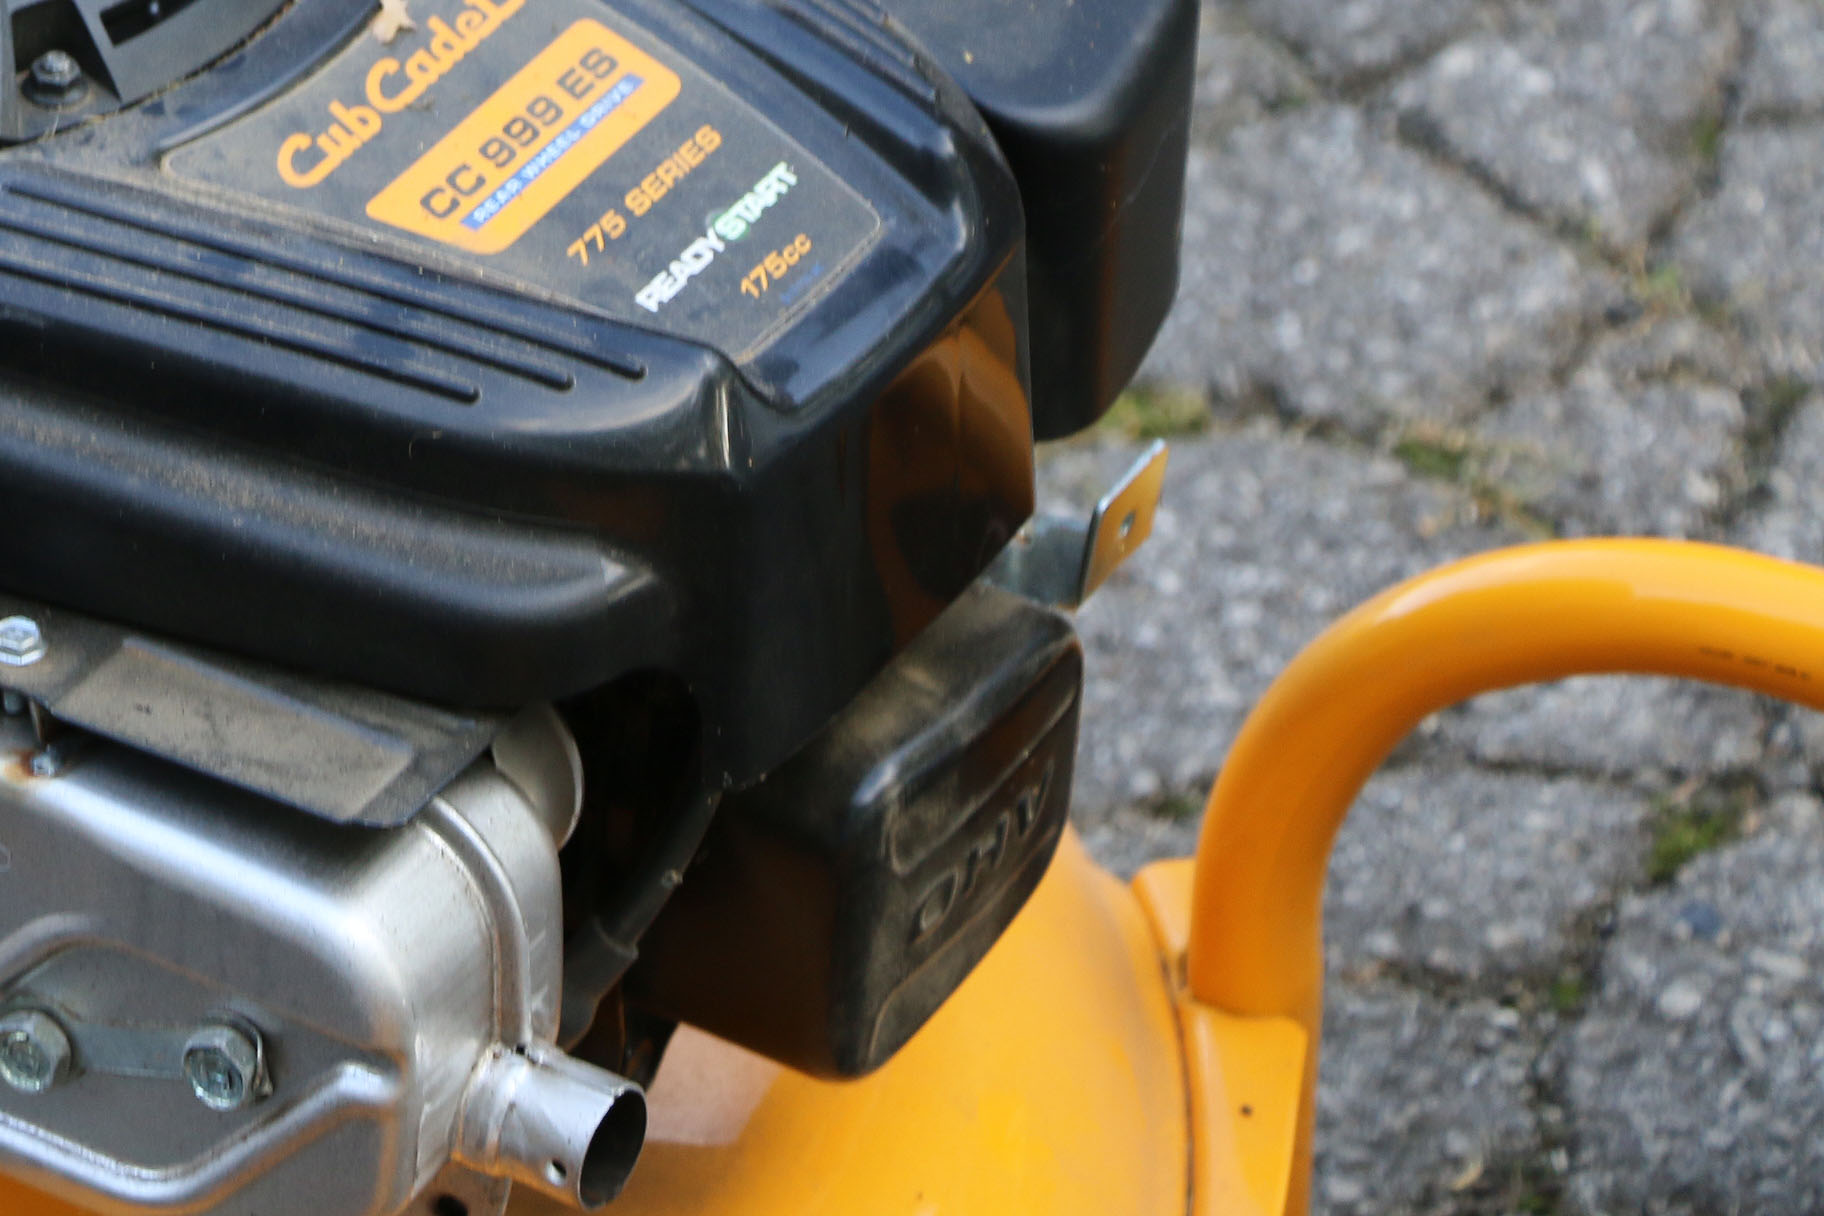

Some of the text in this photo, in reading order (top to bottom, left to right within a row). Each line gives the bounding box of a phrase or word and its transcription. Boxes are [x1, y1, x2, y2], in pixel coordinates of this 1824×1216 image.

[419, 47, 619, 219] CC 999 ES
[566, 123, 723, 267] 775 SERIES
[740, 232, 812, 300] 175cc
[910, 756, 1054, 942] OHV
